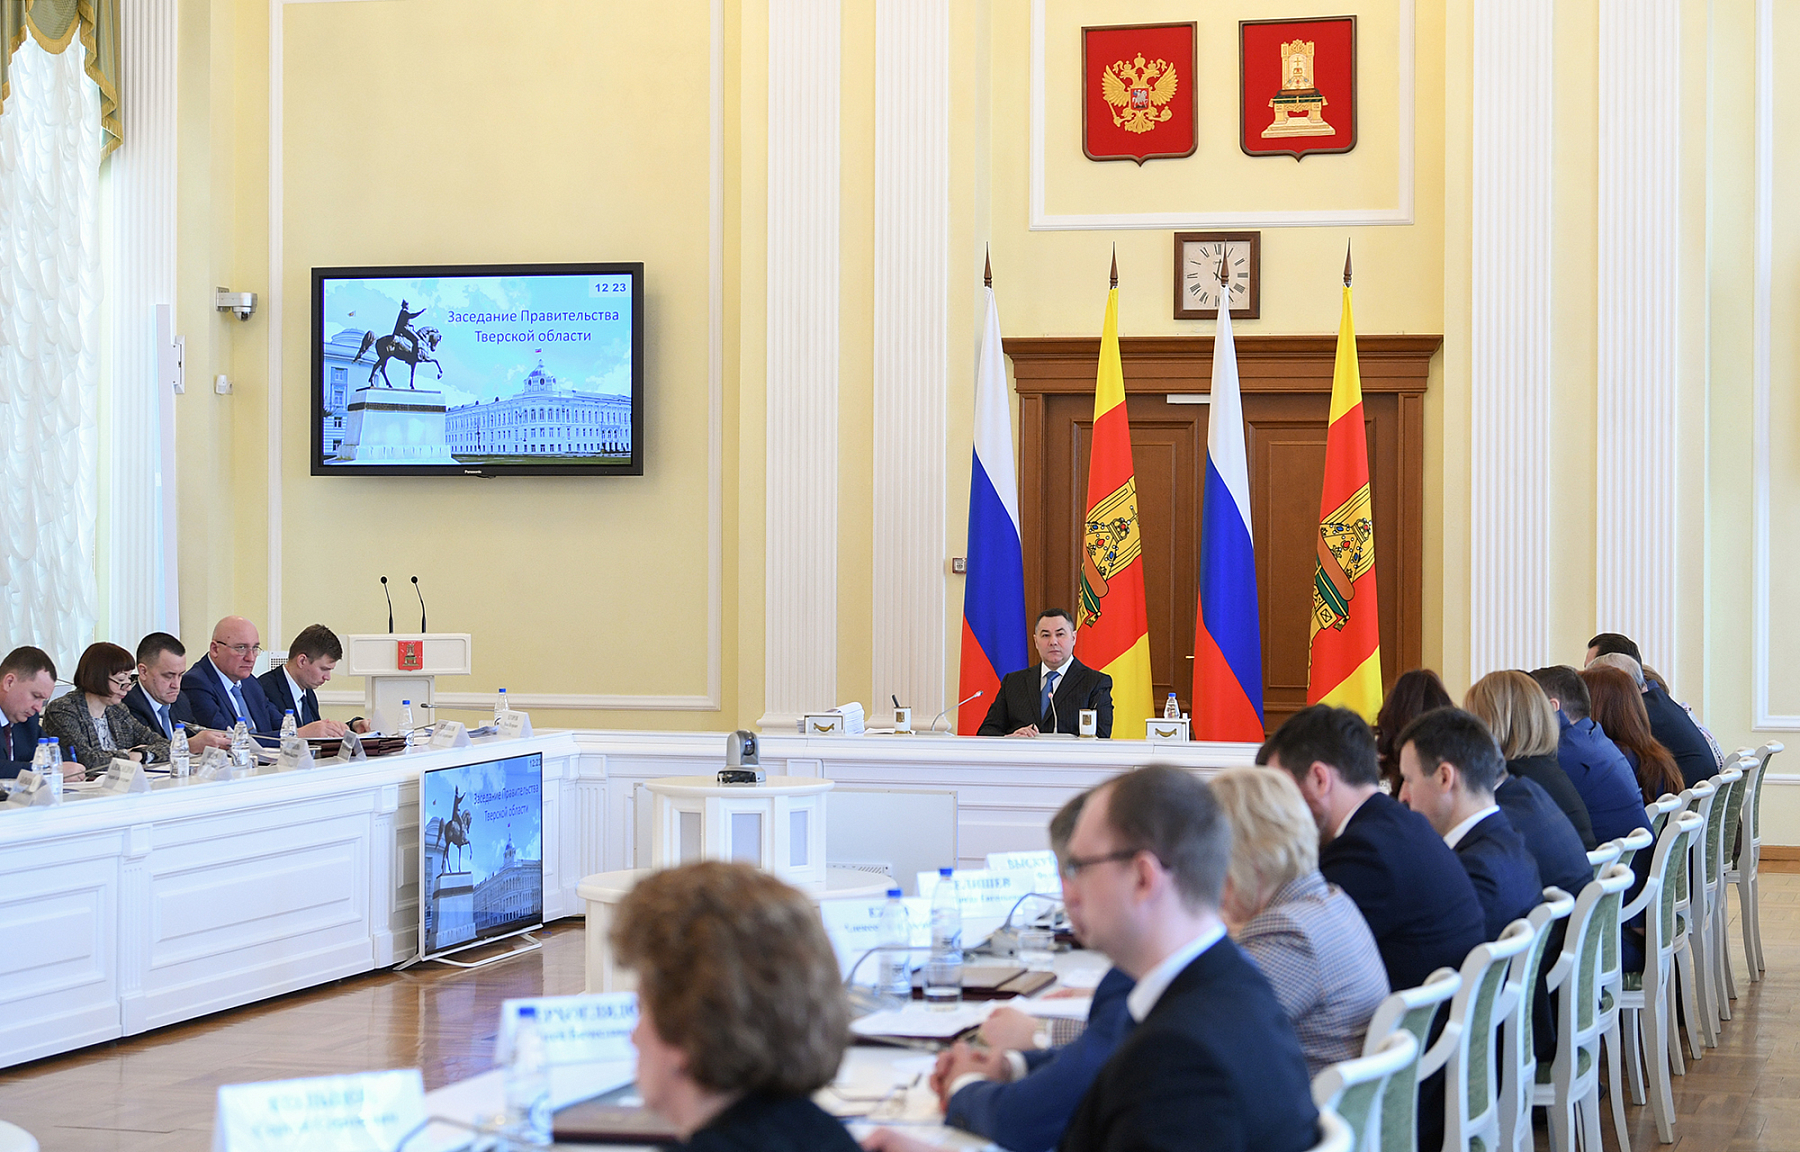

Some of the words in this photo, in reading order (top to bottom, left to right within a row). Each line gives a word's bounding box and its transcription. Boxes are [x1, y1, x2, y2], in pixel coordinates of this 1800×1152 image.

[595, 283, 609, 293] 12
[612, 283, 627, 293] 23
[448, 310, 518, 324] Заседание
[520, 310, 619, 324] Правительства
[474, 329, 535, 345] Тверской
[538, 329, 592, 343] области
[474, 792, 501, 805] Заседание
[502, 784, 539, 800] Правительства
[485, 806, 508, 822] Тверской
[509, 804, 528, 816] области
